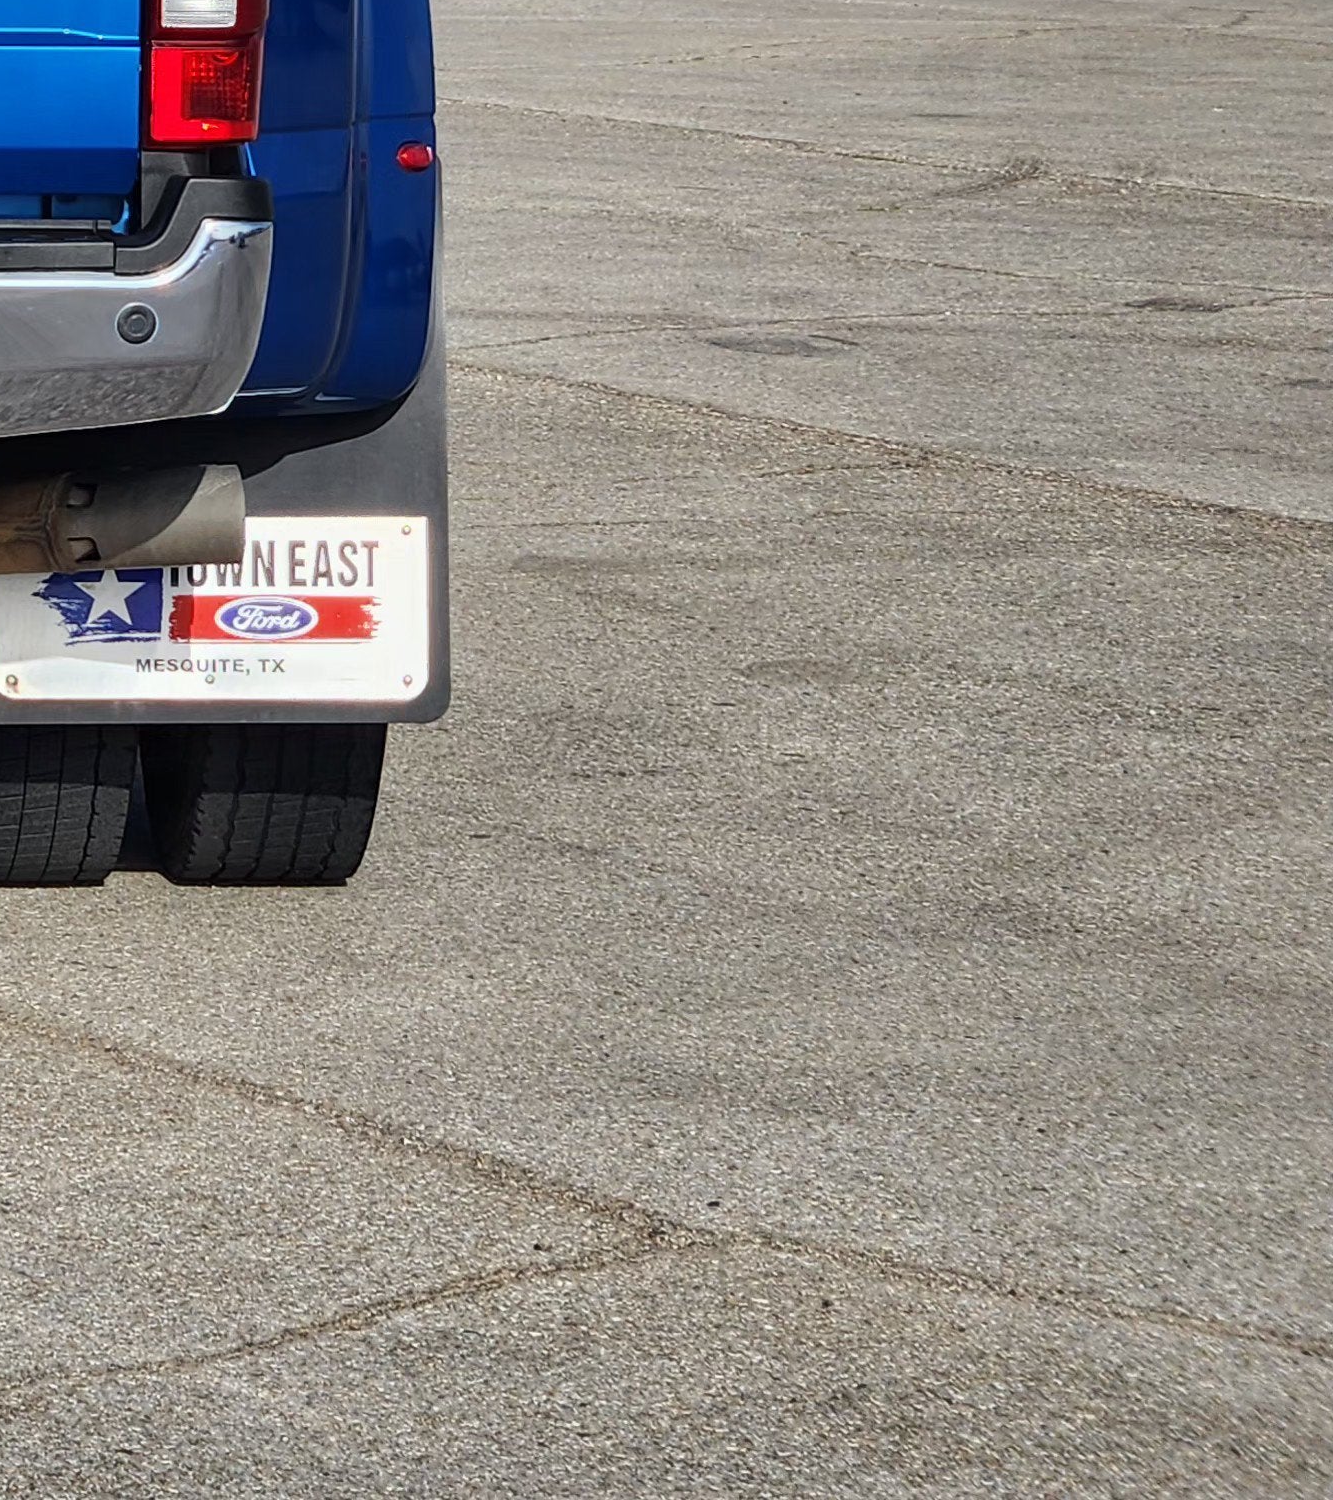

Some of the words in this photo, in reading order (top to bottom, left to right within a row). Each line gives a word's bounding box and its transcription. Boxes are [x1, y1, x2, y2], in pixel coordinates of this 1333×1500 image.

[288, 540, 380, 588] EAST
[233, 603, 302, 631] Ford
[135, 658, 251, 676] MESQUITE,
[257, 658, 286, 674] TX
